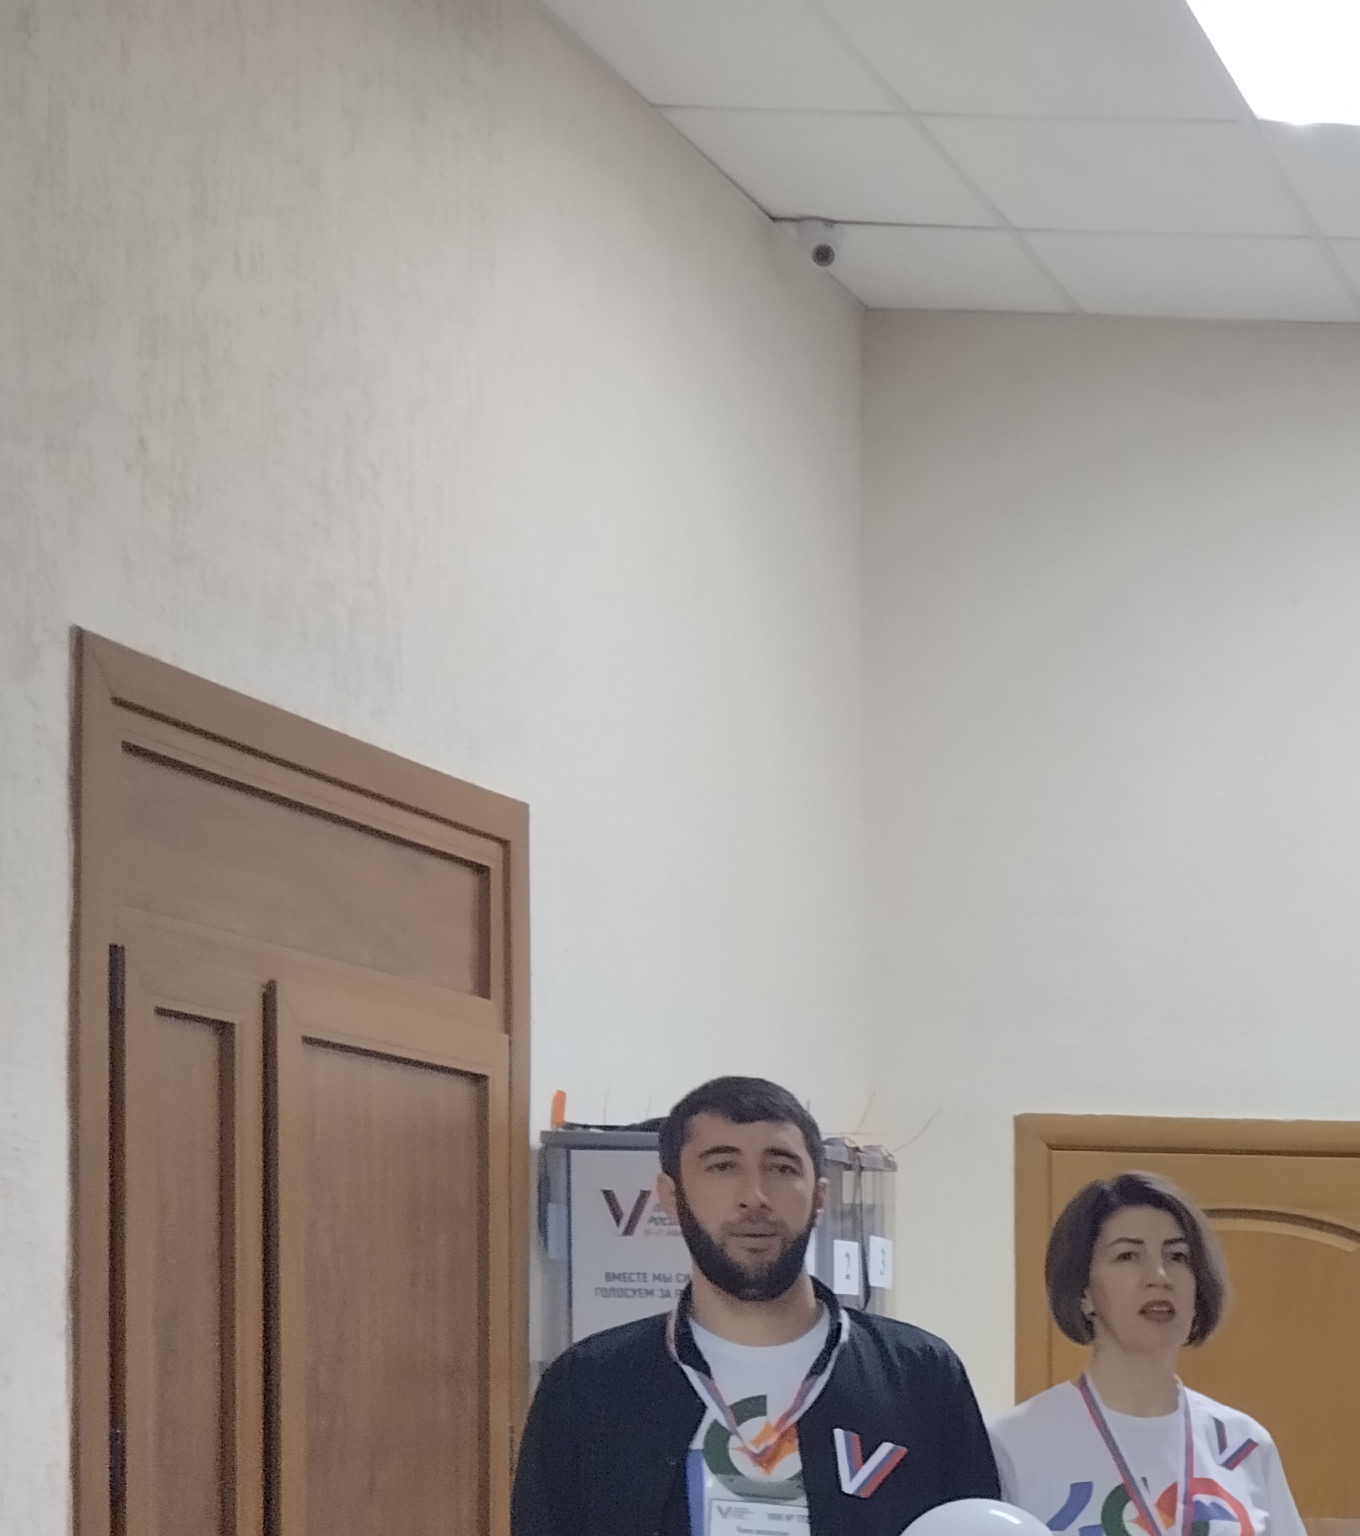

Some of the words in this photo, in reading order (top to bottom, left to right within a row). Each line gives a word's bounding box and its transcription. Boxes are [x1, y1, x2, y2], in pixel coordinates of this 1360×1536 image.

[844, 1251, 851, 1281] 2
[604, 1272, 649, 1283] ВМЕСТЕ
[651, 1272, 673, 1284] МЫ
[594, 1286, 655, 1299] ГОЛОСУЕМ
[658, 1287, 673, 1299] ЗА
